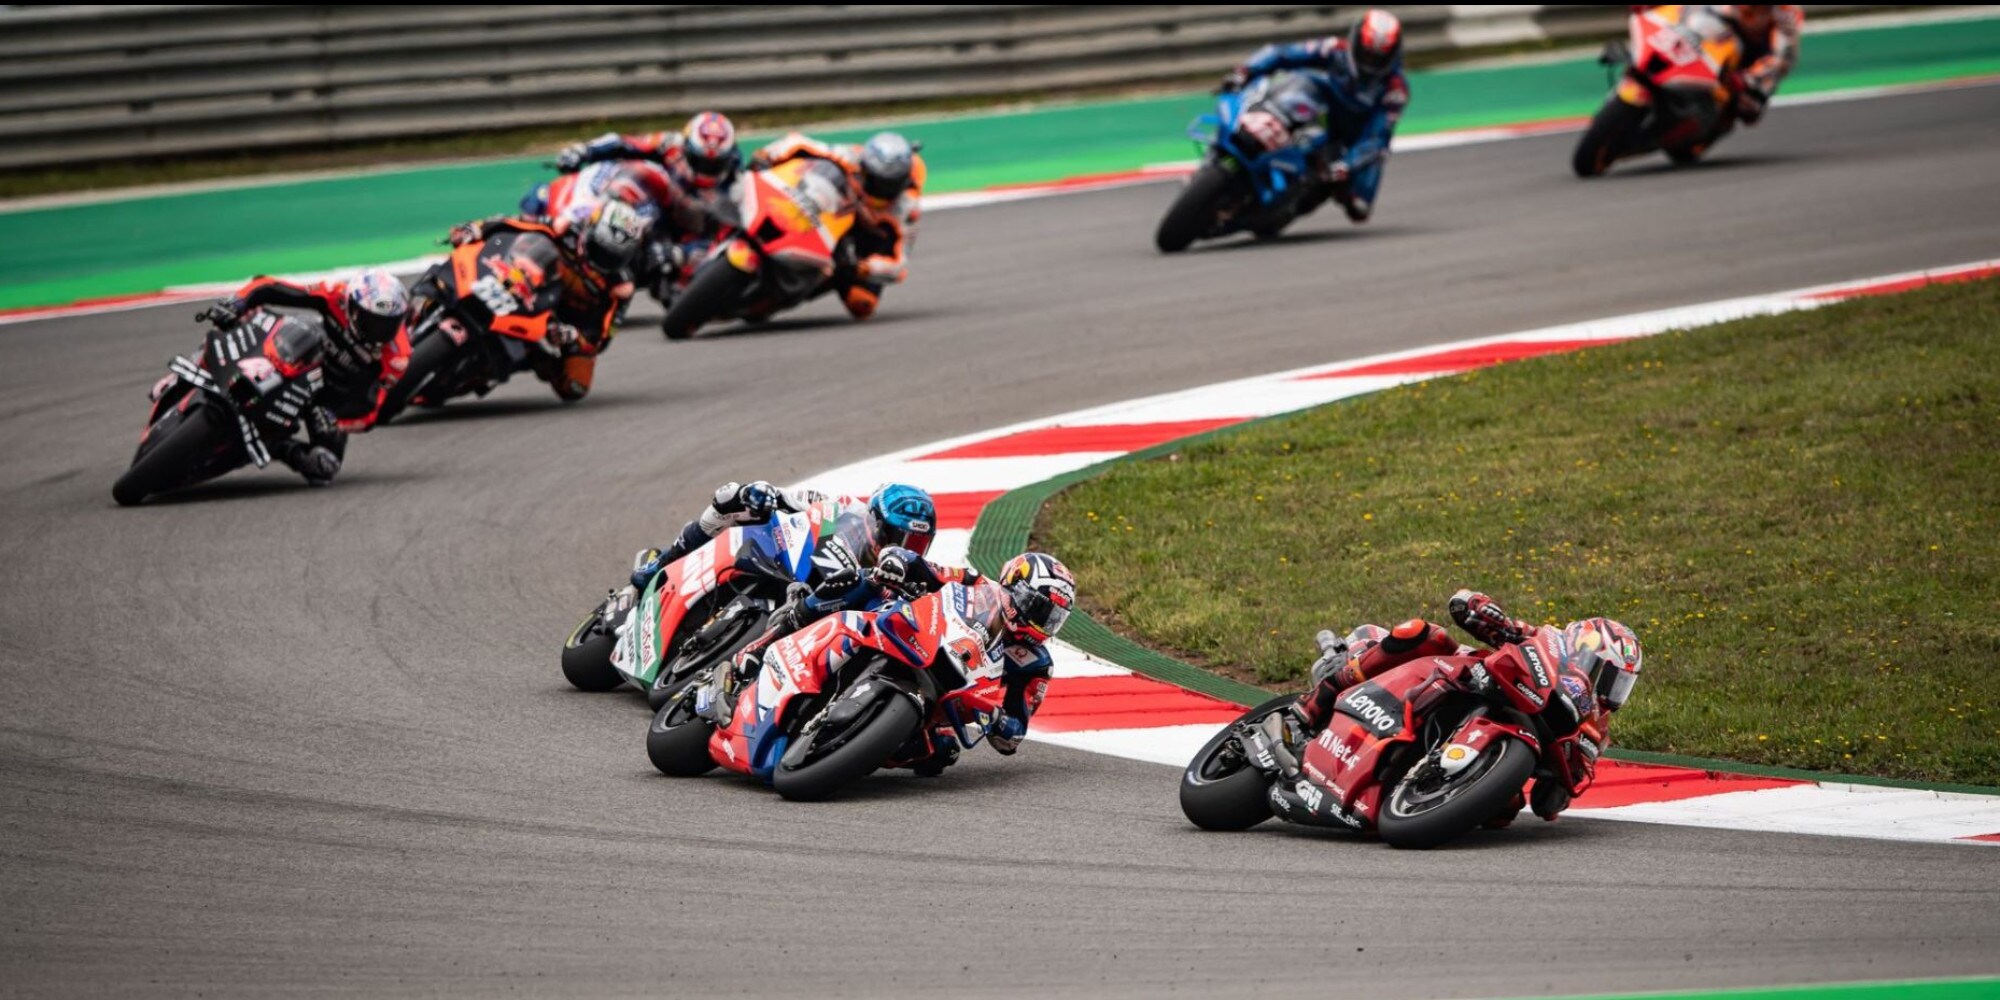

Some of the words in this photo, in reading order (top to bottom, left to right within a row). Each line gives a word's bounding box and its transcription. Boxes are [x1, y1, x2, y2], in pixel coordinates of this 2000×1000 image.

[780, 636, 811, 682] PRAMAC
[1525, 645, 1549, 686] Lenovo
[1345, 687, 1395, 731] Lenovo
[1516, 682, 1544, 706] CARRERA
